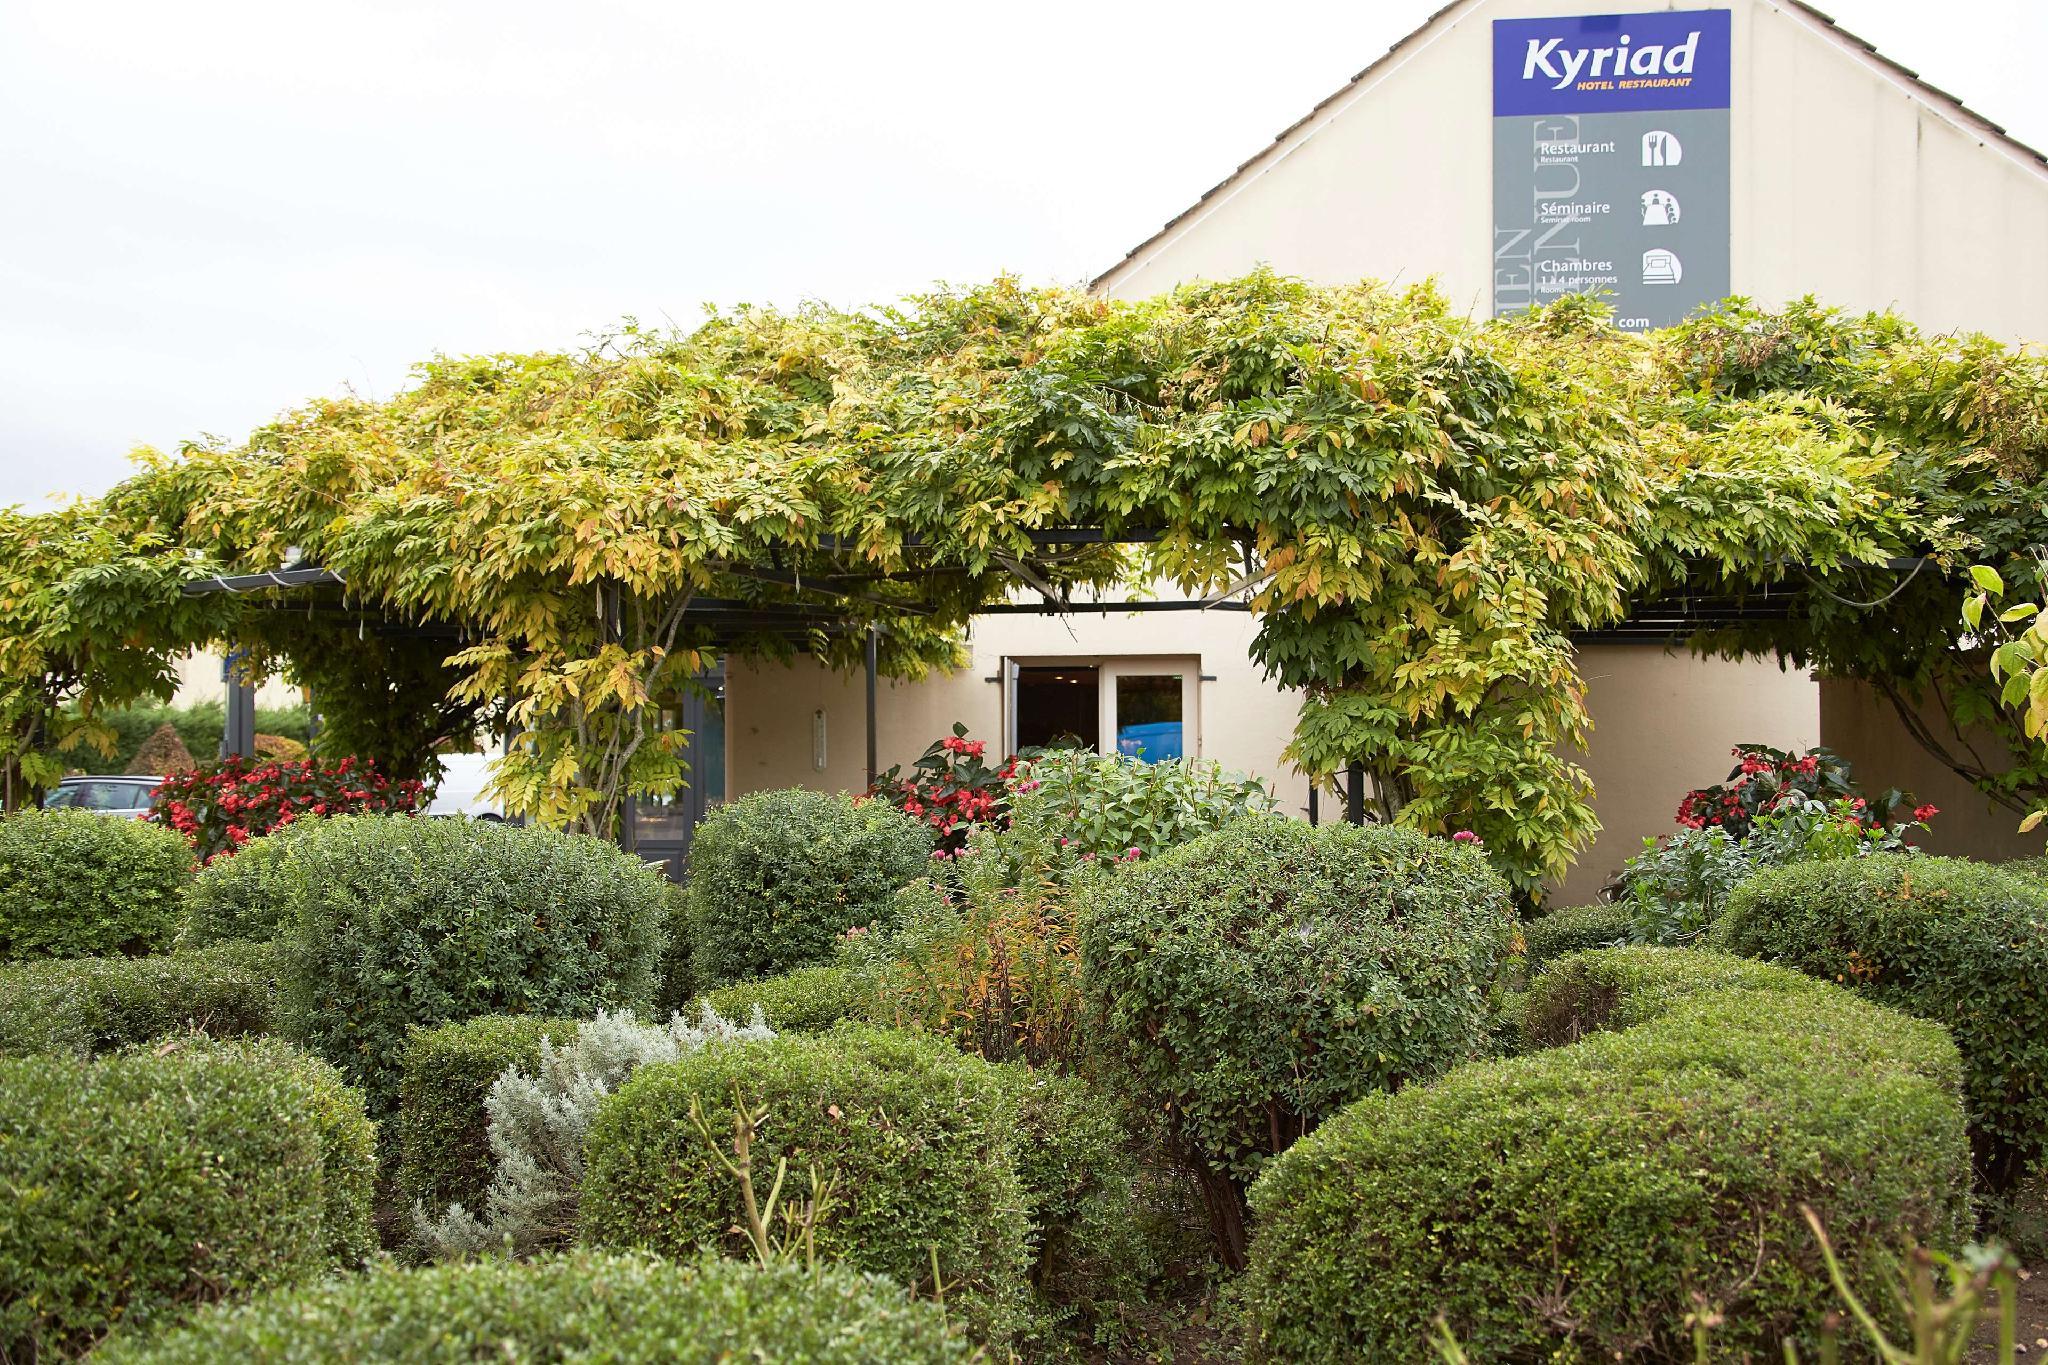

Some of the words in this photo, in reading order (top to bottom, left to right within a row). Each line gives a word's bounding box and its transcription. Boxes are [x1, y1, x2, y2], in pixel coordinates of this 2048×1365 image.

[1522, 31, 1701, 90] Kyriad
[1577, 81, 1614, 91] HOTEL
[1618, 77, 1692, 89] RESTAURANT
[1540, 140, 1615, 155] Restaurant
[1540, 155, 1579, 163] Restaurant
[1534, 114, 1580, 307] ENUE
[1541, 201, 1610, 215] Séminaire
[1541, 216, 1570, 224] Semin
[1541, 259, 1612, 272] Chambres
[1541, 276, 1546, 284] 1
[1559, 275, 1565, 284] 4
[1568, 276, 1618, 287] personnes
